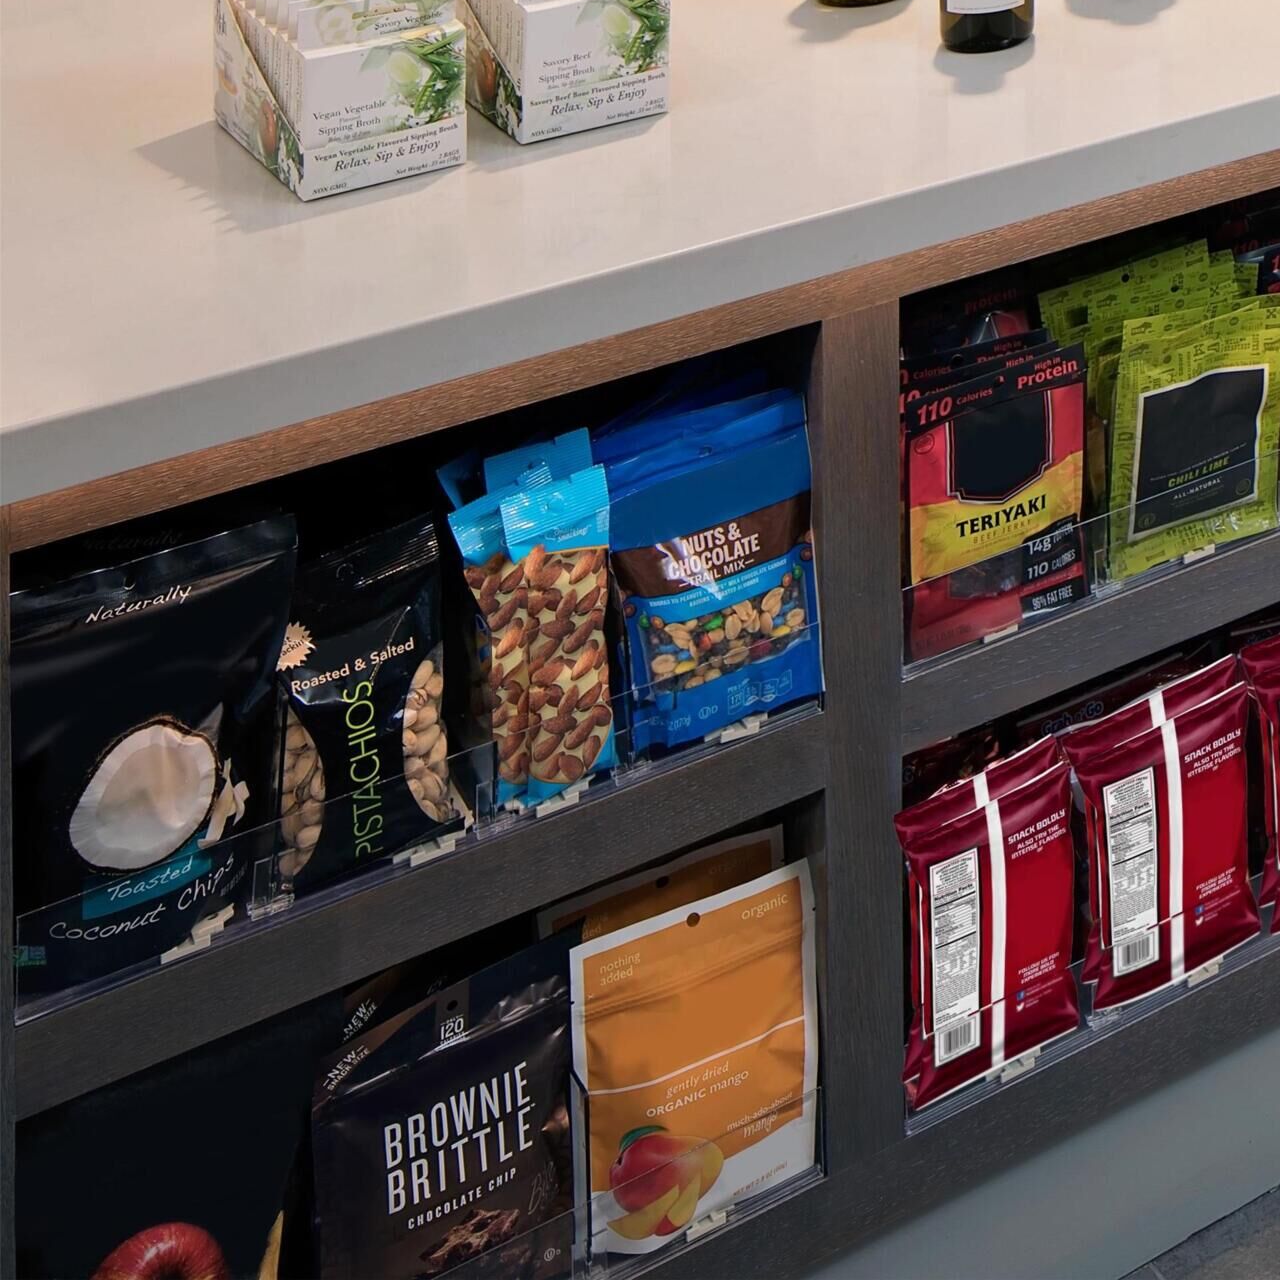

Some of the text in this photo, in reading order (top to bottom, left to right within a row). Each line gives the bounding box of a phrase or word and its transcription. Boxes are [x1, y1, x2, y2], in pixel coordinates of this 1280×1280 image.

[374, 10, 443, 30] Savory Vegetable
[542, 51, 592, 68] Savory Beef
[538, 72, 570, 84] Sipping
[572, 67, 595, 77] Broth
[530, 98, 553, 107] Savory
[555, 92, 571, 102] Beef
[591, 84, 620, 94] Flavored
[622, 77, 646, 89] Sipping
[550, 88, 647, 116] Relax, Sip & Enjoy
[313, 100, 387, 121] Vegan Vegetable
[318, 117, 381, 136] Sipping Broth
[547, 126, 562, 134] GMO
[314, 123, 458, 161] Vegan Vegetable Flavored Sipping Broth
[334, 139, 441, 172] Relax, Sip & Enjoy
[312, 182, 347, 195] NON GMO
[1005, 354, 1033, 368] High in
[1034, 356, 1061, 370] High in
[917, 359, 1078, 425] 110 calories Protein
[1168, 468, 1200, 488] CHILI
[1202, 456, 1230, 474] LIME
[1173, 477, 1221, 500] ALL-NATURAL
[956, 493, 1047, 538] TERIYAKI
[681, 522, 741, 556] NUTS &
[973, 519, 1032, 544] BEEF JERKY
[668, 533, 761, 580] CHOCOLATE
[1027, 538, 1052, 556] 14g
[688, 562, 745, 587] TRAIL MIX
[1027, 562, 1049, 580] 110
[86, 583, 193, 626] Naturally
[1032, 585, 1073, 611] 96% FAT FREE
[291, 637, 415, 693] Roasted & Salted
[1185, 728, 1242, 763] SNACK BOLDLY
[1193, 743, 1235, 769] ALSO THE
[343, 680, 384, 857] PISTACHIOS
[1187, 747, 1242, 778] INTENSE FLAVORS
[1008, 808, 1066, 845] SNACK BOLDLY
[1017, 824, 1060, 850] ALSO THE
[1011, 827, 1066, 860] INTENSE FLAVORS
[108, 856, 194, 902] Toasted
[934, 883, 973, 902] Nutrition Facts
[1196, 876, 1218, 891] FOLLOW
[1199, 879, 1233, 899] EXPERIENCES
[1201, 874, 1231, 893] MORE BOLD
[49, 903, 166, 940] Coconut
[178, 852, 234, 910] Chips
[741, 892, 789, 922] organic
[599, 951, 641, 975] nothing
[600, 966, 633, 986] added
[1018, 960, 1041, 975] FOLLOW
[1021, 965, 1056, 984] EXPERIENCES
[1023, 960, 1055, 978] MORE BOLD
[343, 1002, 367, 1034] NEW
[441, 1018, 465, 1041] 120
[326, 1048, 370, 1091] SNACK SIZE
[329, 1050, 358, 1079] NEW
[666, 1060, 730, 1098] gently dried
[646, 1070, 750, 1118] ORGANIC mango
[384, 1061, 530, 1170] BROWNIE
[726, 1092, 794, 1131] much-ado-about
[744, 1112, 777, 1138] mango
[387, 1106, 533, 1214] BRITTLE
[408, 1186, 482, 1229] CHOCOLATE
[488, 1167, 517, 1192] CHIP
